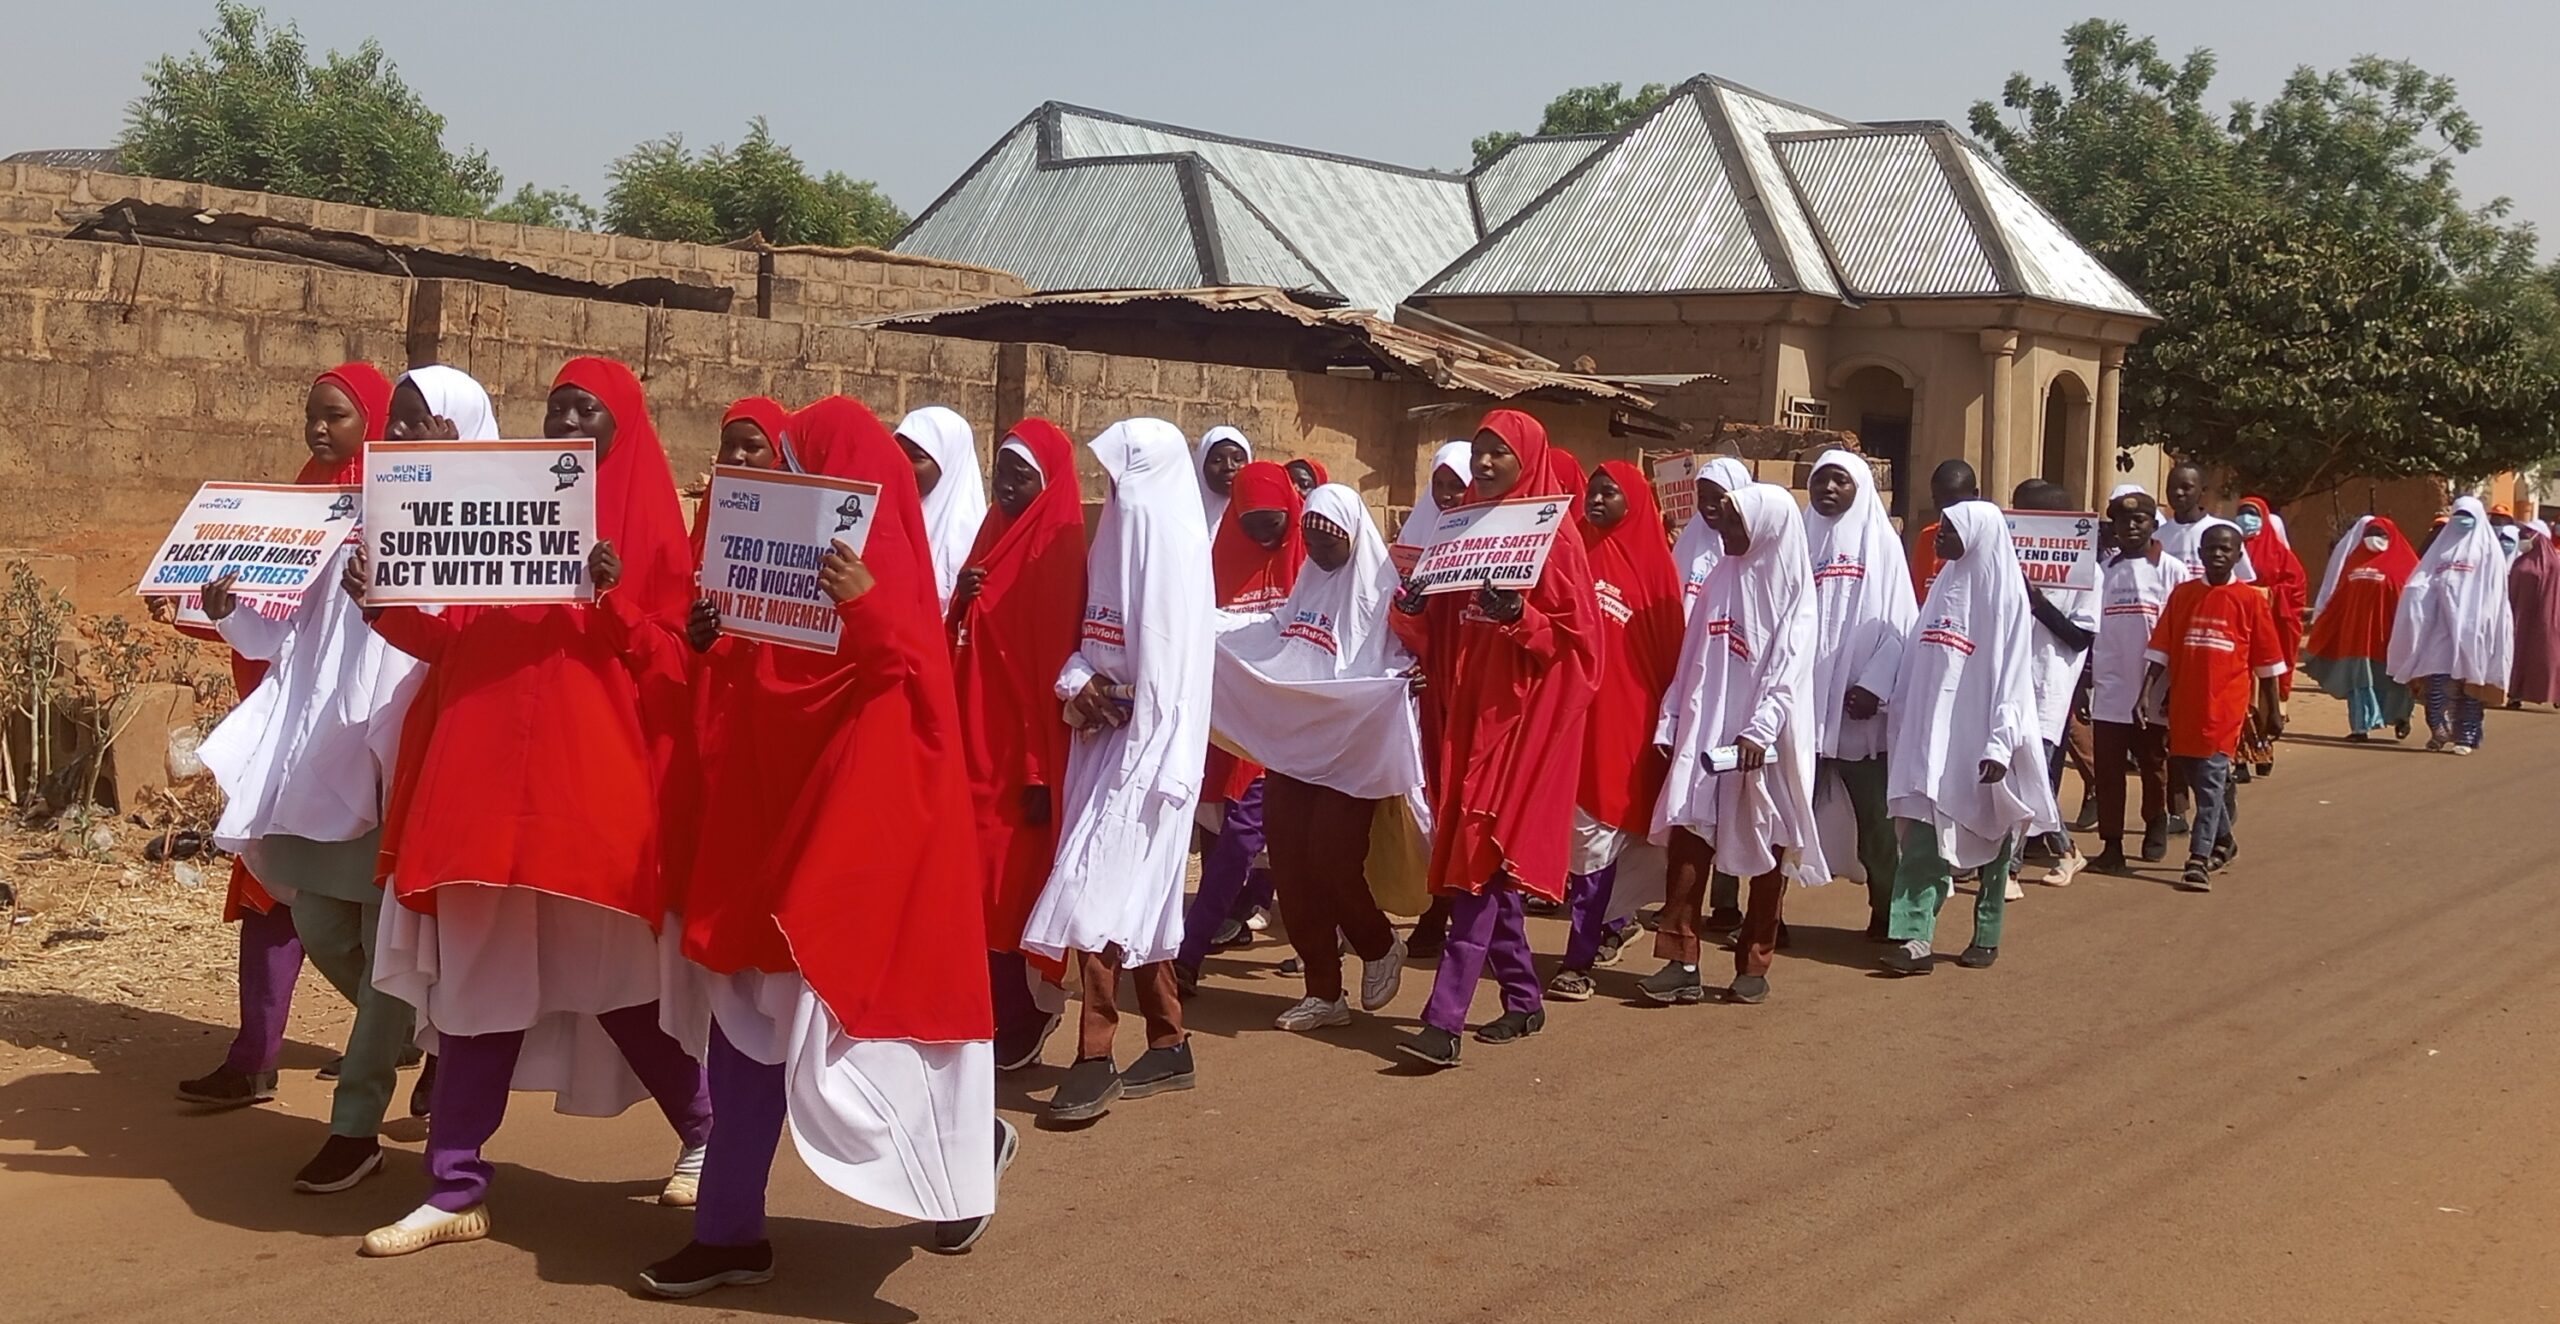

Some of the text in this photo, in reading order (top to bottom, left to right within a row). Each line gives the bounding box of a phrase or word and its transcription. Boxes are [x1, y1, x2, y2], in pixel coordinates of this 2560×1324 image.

[376, 473, 417, 482] WOMEN
[402, 464, 417, 473] UN
[461, 501, 561, 526] BELIEVE
[719, 499, 749, 511] WOMEN
[267, 527, 302, 545] HAS
[300, 530, 327, 546] NO
[380, 531, 532, 556] SURVIVORS
[540, 531, 580, 555] WE
[1462, 537, 1499, 552] MAKE
[1499, 533, 1553, 549] SAFETY
[164, 544, 322, 567] PLACE IN OUR HOMES,
[1422, 549, 1537, 573] A REALITY FOR ALL
[2025, 549, 2049, 561] END
[2052, 551, 2079, 562] GBV
[239, 566, 309, 585] STREETS
[375, 561, 582, 587] ACT WITH THEM
[727, 564, 821, 600] FOR VIOLENCE
[1461, 567, 1489, 581] AND
[1491, 564, 1534, 580] GIRLS
[736, 594, 764, 621] THE
[765, 599, 837, 634] MOVEMENT
